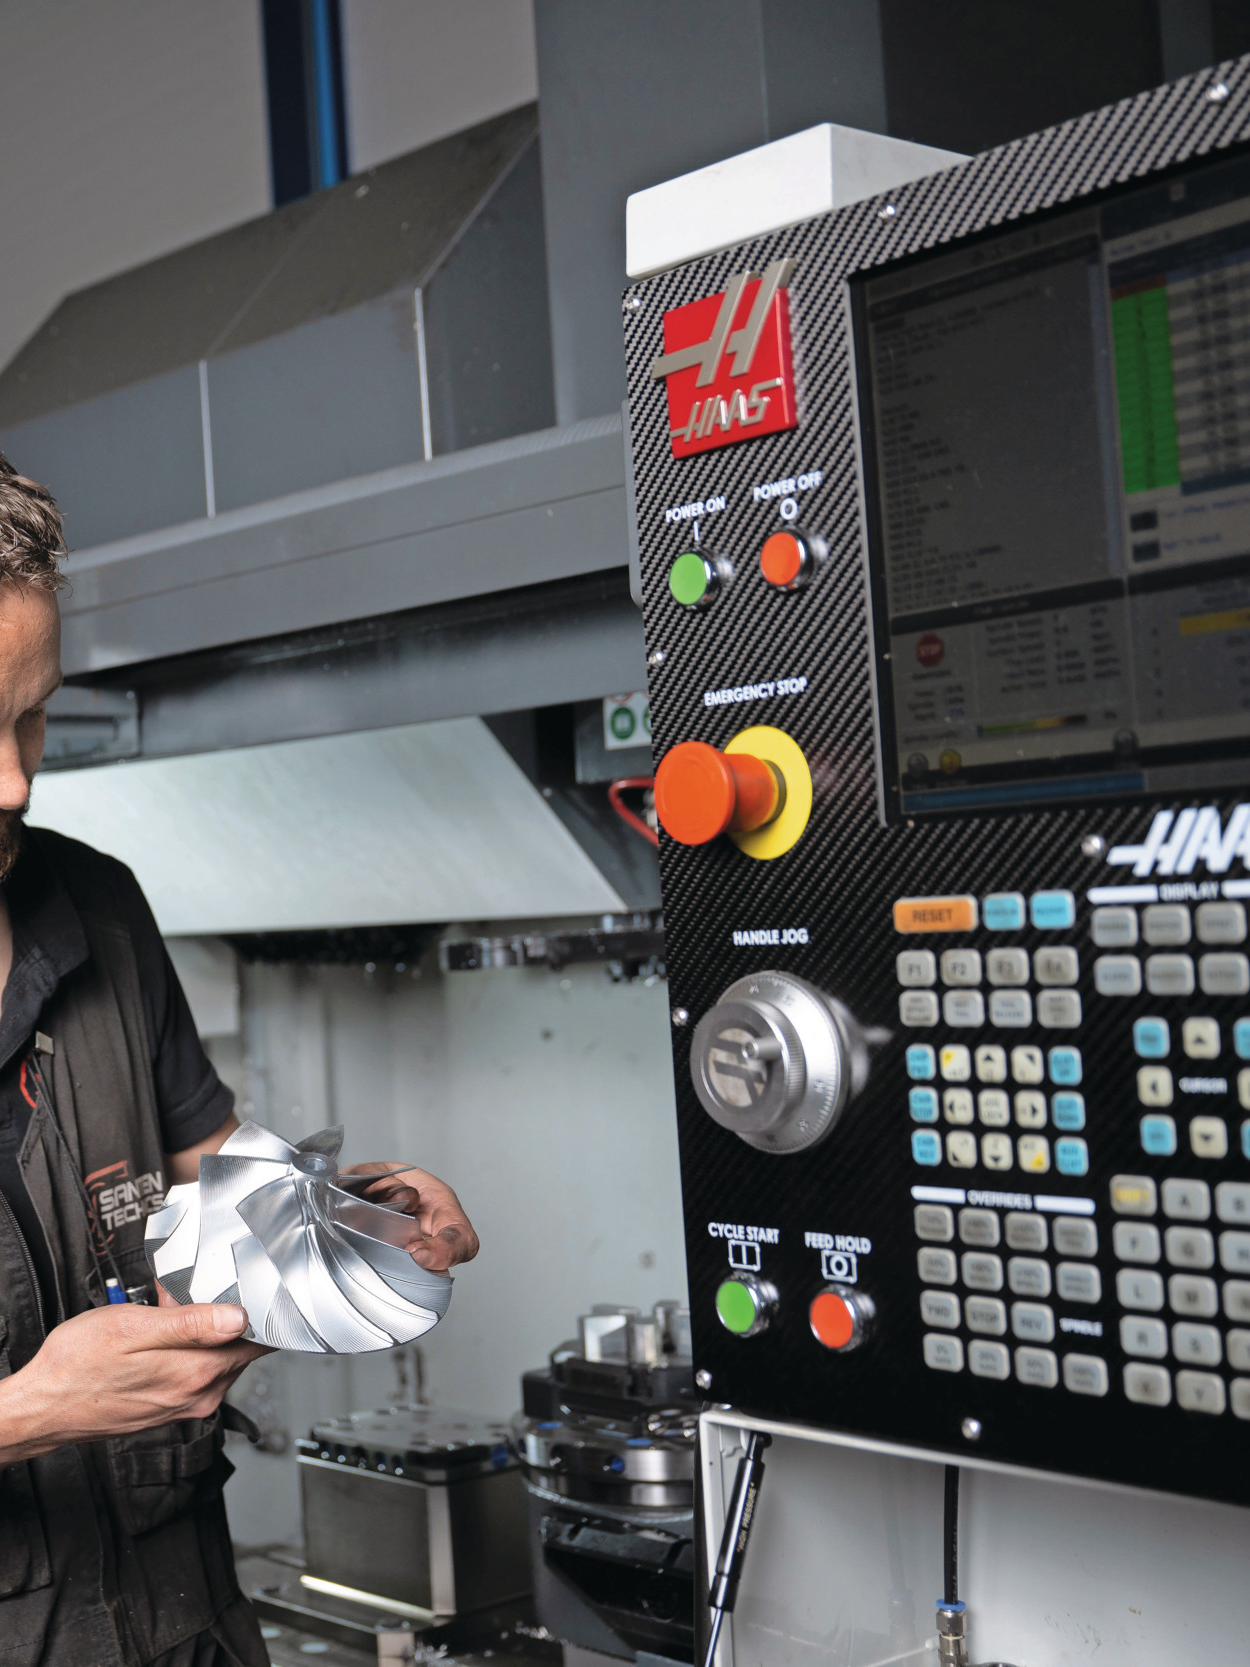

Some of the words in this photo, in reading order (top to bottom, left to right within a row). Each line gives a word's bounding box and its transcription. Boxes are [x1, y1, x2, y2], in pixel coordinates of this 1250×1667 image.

[670, 376, 784, 443] HAAS
[753, 478, 796, 501] POWER
[797, 470, 823, 490] OFF
[665, 501, 704, 523] POWER
[706, 496, 726, 513] ON
[703, 682, 775, 707] EMERGENCY
[776, 676, 808, 696] STOP
[911, 908, 954, 924] RESET
[733, 930, 780, 946] HANDLE
[781, 928, 809, 944] JOG
[907, 963, 922, 978] F1
[952, 962, 967, 977] F2
[967, 1189, 1033, 1210] OVERRIDES
[708, 1222, 745, 1240] CYCLE
[746, 1226, 780, 1244] START
[804, 1231, 834, 1249] FEED
[835, 1235, 871, 1254] HOLD
